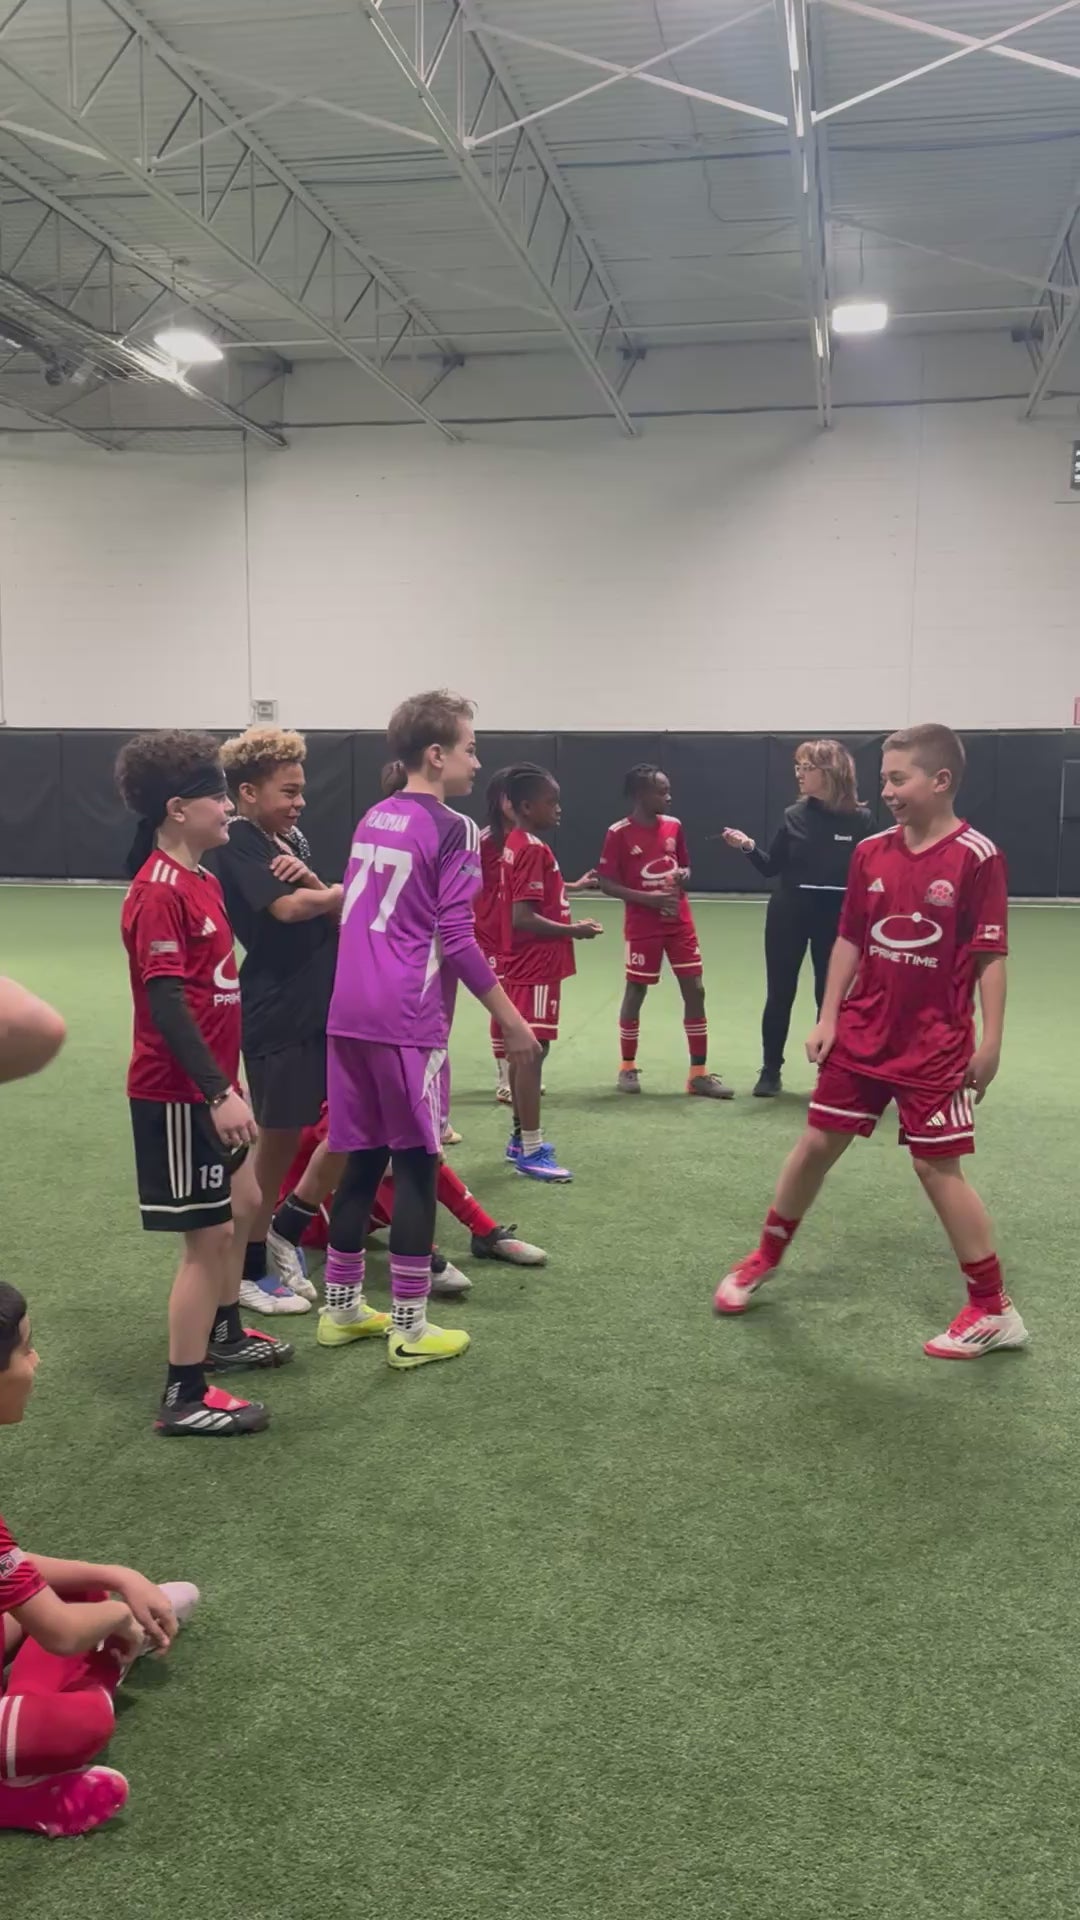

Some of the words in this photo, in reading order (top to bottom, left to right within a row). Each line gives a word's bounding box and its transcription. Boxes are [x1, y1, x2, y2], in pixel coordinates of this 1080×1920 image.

[340, 842, 413, 933] 77
[631, 952, 645, 966] 20
[199, 1164, 224, 1190] 19
